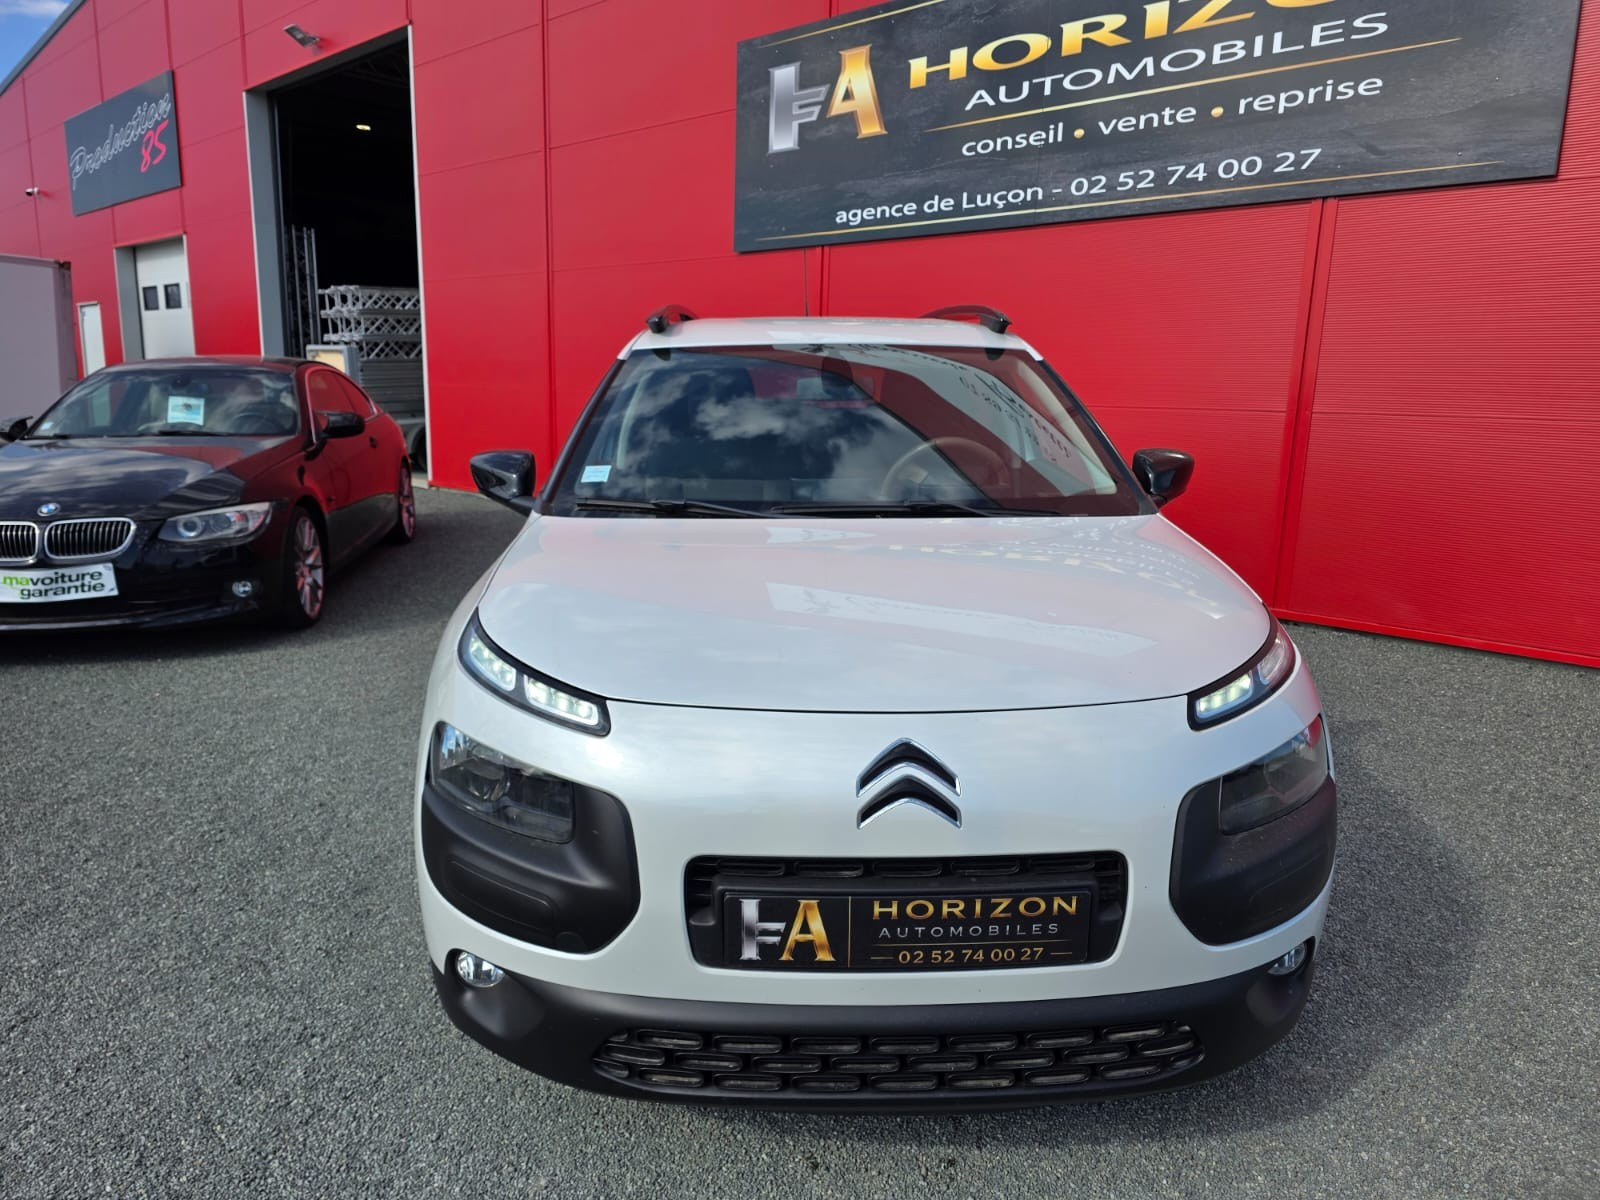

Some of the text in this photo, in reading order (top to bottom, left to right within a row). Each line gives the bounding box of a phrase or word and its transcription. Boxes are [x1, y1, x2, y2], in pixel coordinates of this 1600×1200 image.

[909, 0, 1336, 89] HORIZ
[964, 12, 1388, 112] AUTOMOBILES
[961, 77, 1384, 156] conseil vente reprise
[140, 119, 169, 173] 85
[835, 199, 917, 226] agence
[923, 194, 955, 214] de
[961, 185, 1043, 210] Luçon
[1070, 174, 1107, 196] 02
[1116, 169, 1155, 191] 52
[1167, 163, 1207, 186] 74
[1217, 156, 1263, 180] 00
[1273, 148, 1322, 173] 27
[3, 571, 103, 586] mavoiture
[20, 582, 105, 600] garantie
[872, 896, 1078, 920] HORIZON
[878, 923, 1059, 939] AUTOMOBILES
[898, 947, 1044, 965] 02 52 74 00 27
